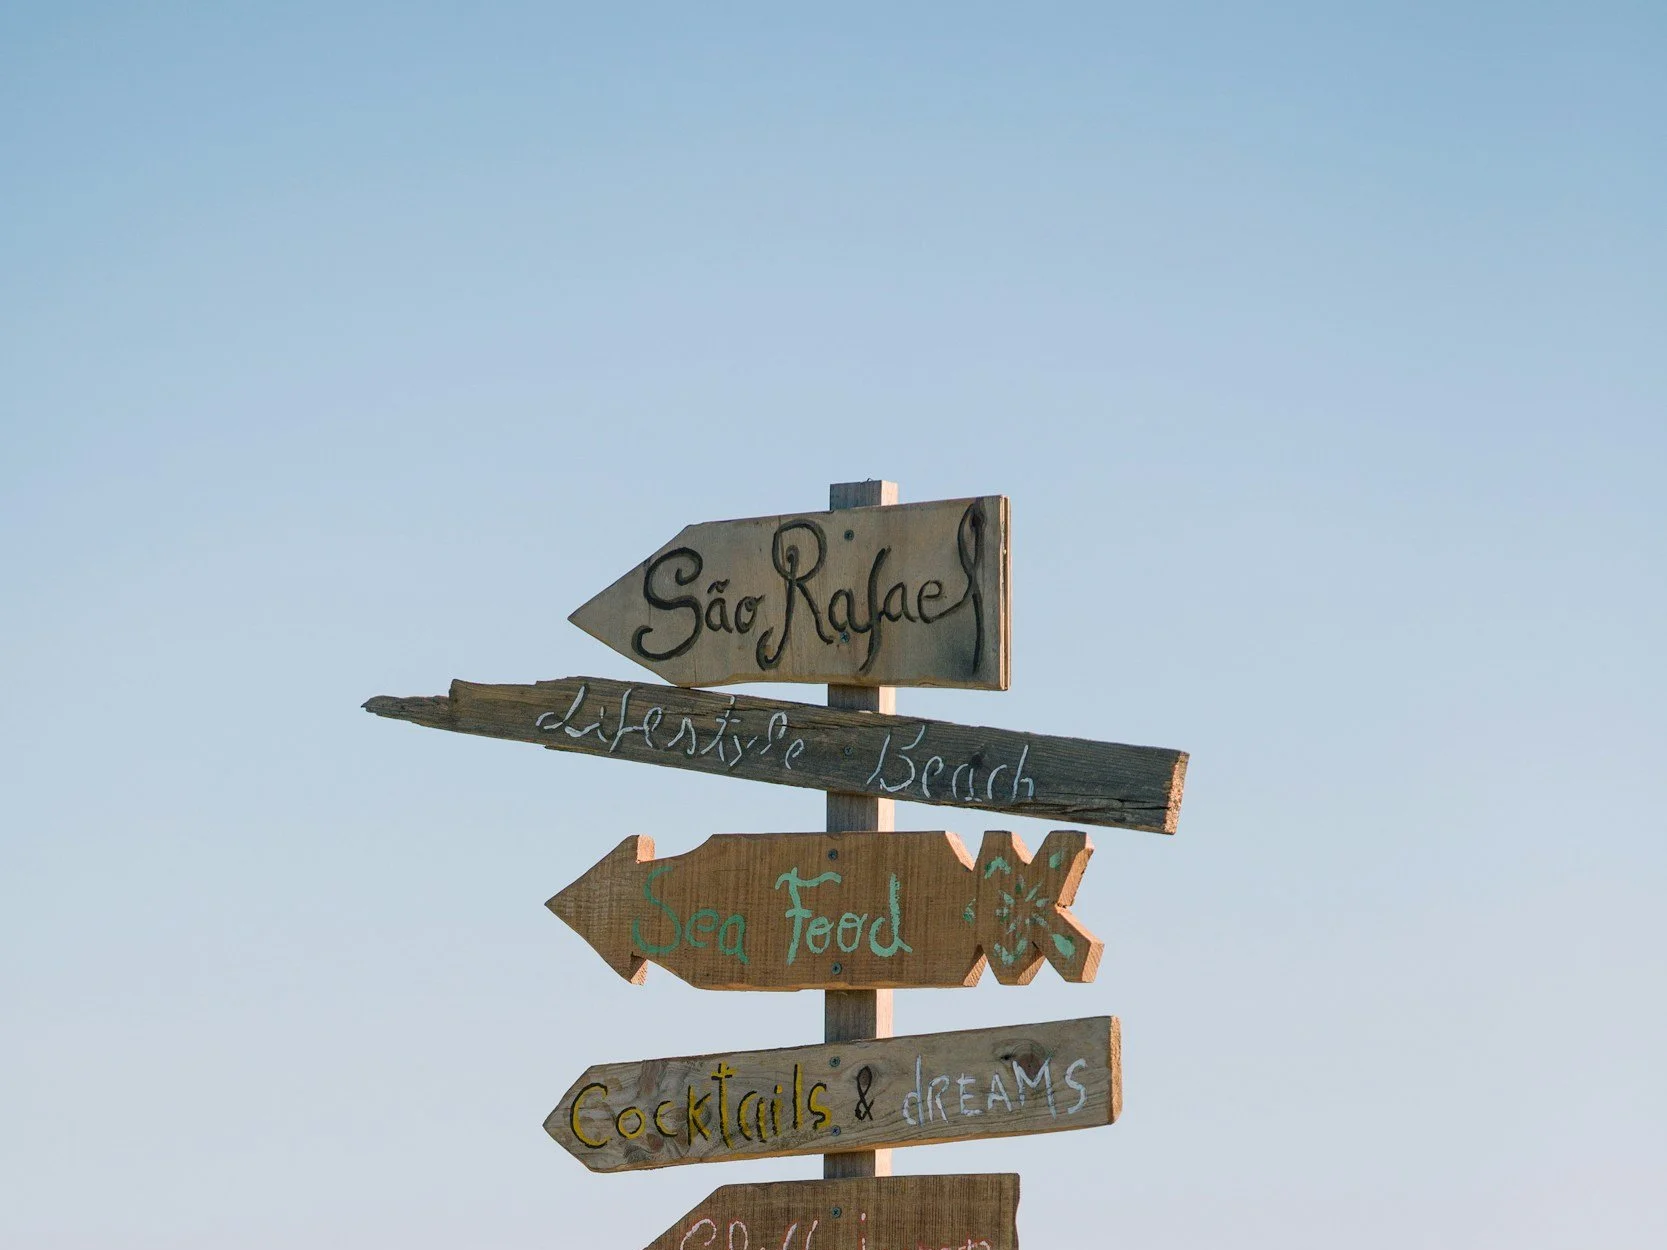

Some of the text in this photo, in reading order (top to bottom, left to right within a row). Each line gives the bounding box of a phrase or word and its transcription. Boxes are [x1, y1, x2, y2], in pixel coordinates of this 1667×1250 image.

[631, 500, 986, 675] São Rafael
[535, 684, 1034, 801] Lifestyle Beach
[632, 866, 913, 966] Sea Food
[569, 1061, 832, 1149] Cocktails
[854, 1065, 876, 1122] &
